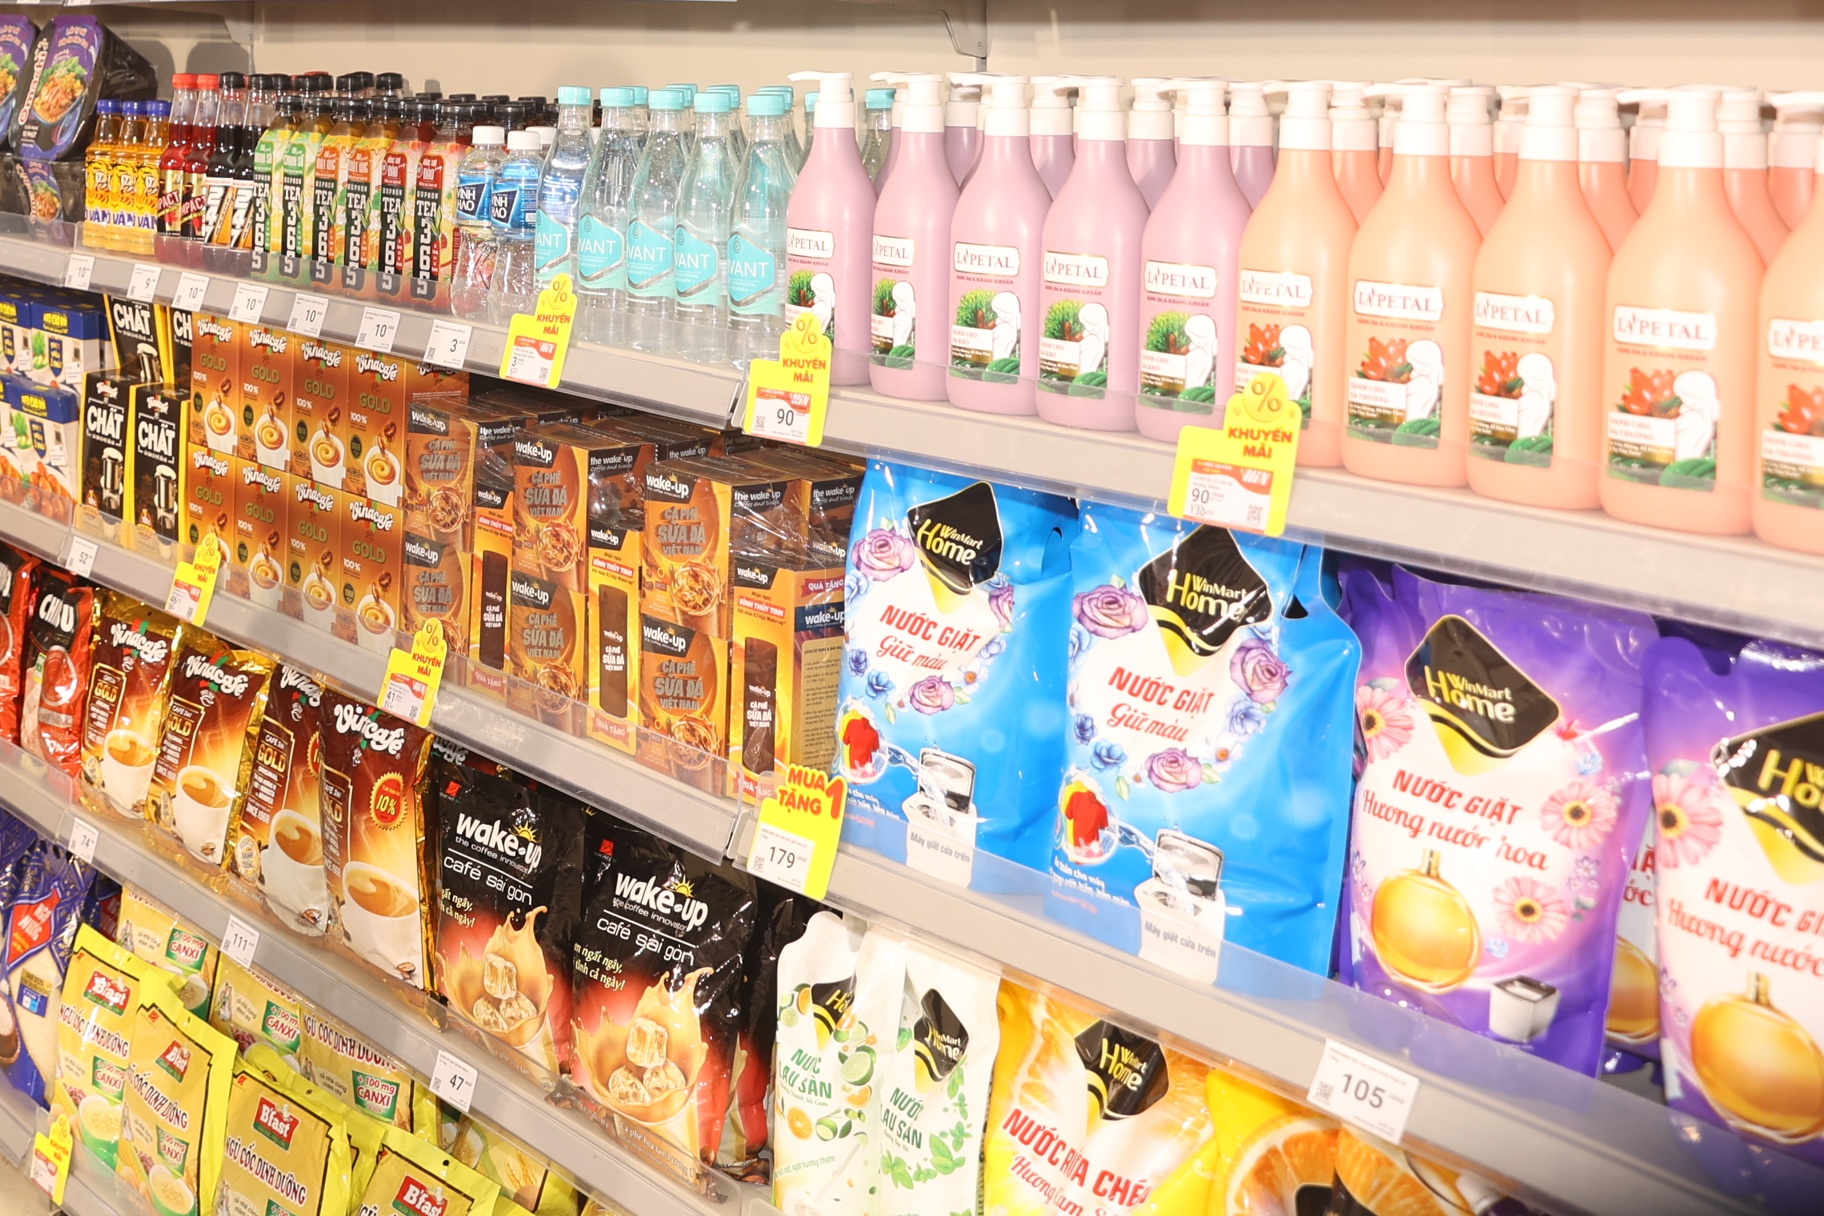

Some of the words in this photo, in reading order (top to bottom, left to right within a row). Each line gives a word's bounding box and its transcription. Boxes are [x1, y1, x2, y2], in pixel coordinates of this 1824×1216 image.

[284, 186, 300, 200] TEA
[316, 190, 332, 205] TEA
[348, 194, 365, 209] TEA
[383, 197, 400, 213] TEA
[246, 298, 256, 310] 10
[305, 309, 316, 323] 10
[375, 323, 387, 337] 10
[450, 339, 457, 353] 3
[200, 353, 227, 372] GOLD
[782, 356, 826, 369] KHUYẾN
[252, 365, 281, 384] GOLD
[359, 393, 391, 414] GOLD
[777, 408, 794, 426] 90
[1228, 426, 1293, 443] KHUYẾN
[1192, 488, 1209, 504] 90
[246, 502, 275, 523] GOLD
[1190, 506, 1206, 516] 130
[917, 519, 976, 565] Home
[940, 523, 983, 550] WinMart
[353, 540, 386, 564] GOLD
[1166, 569, 1245, 619] Home
[1192, 573, 1247, 600] WinMart
[879, 604, 938, 641] NƯỚC
[938, 626, 981, 654] GIẶT
[1108, 666, 1174, 706] NƯỚC
[1173, 687, 1215, 719] GIẶT
[1423, 666, 1515, 724] Home
[1446, 671, 1513, 702] WinMart
[788, 768, 826, 792] MUA
[376, 796, 397, 816] 10%
[779, 788, 821, 816] TẶNG
[826, 779, 844, 820] 1
[1392, 768, 1465, 809] NƯỚC
[1464, 792, 1523, 826] GIẶT
[770, 846, 796, 868] 179
[443, 856, 482, 881] café
[1705, 877, 1792, 928] NƯỚC
[596, 917, 631, 941] café
[636, 932, 662, 953] sài
[169, 941, 200, 961] CANXI
[1099, 1038, 1143, 1091] Home
[449, 1075, 464, 1090] 47
[1341, 1073, 1386, 1110] 105
[356, 1086, 391, 1108] CANXI
[1002, 1107, 1067, 1166] NƯỚC
